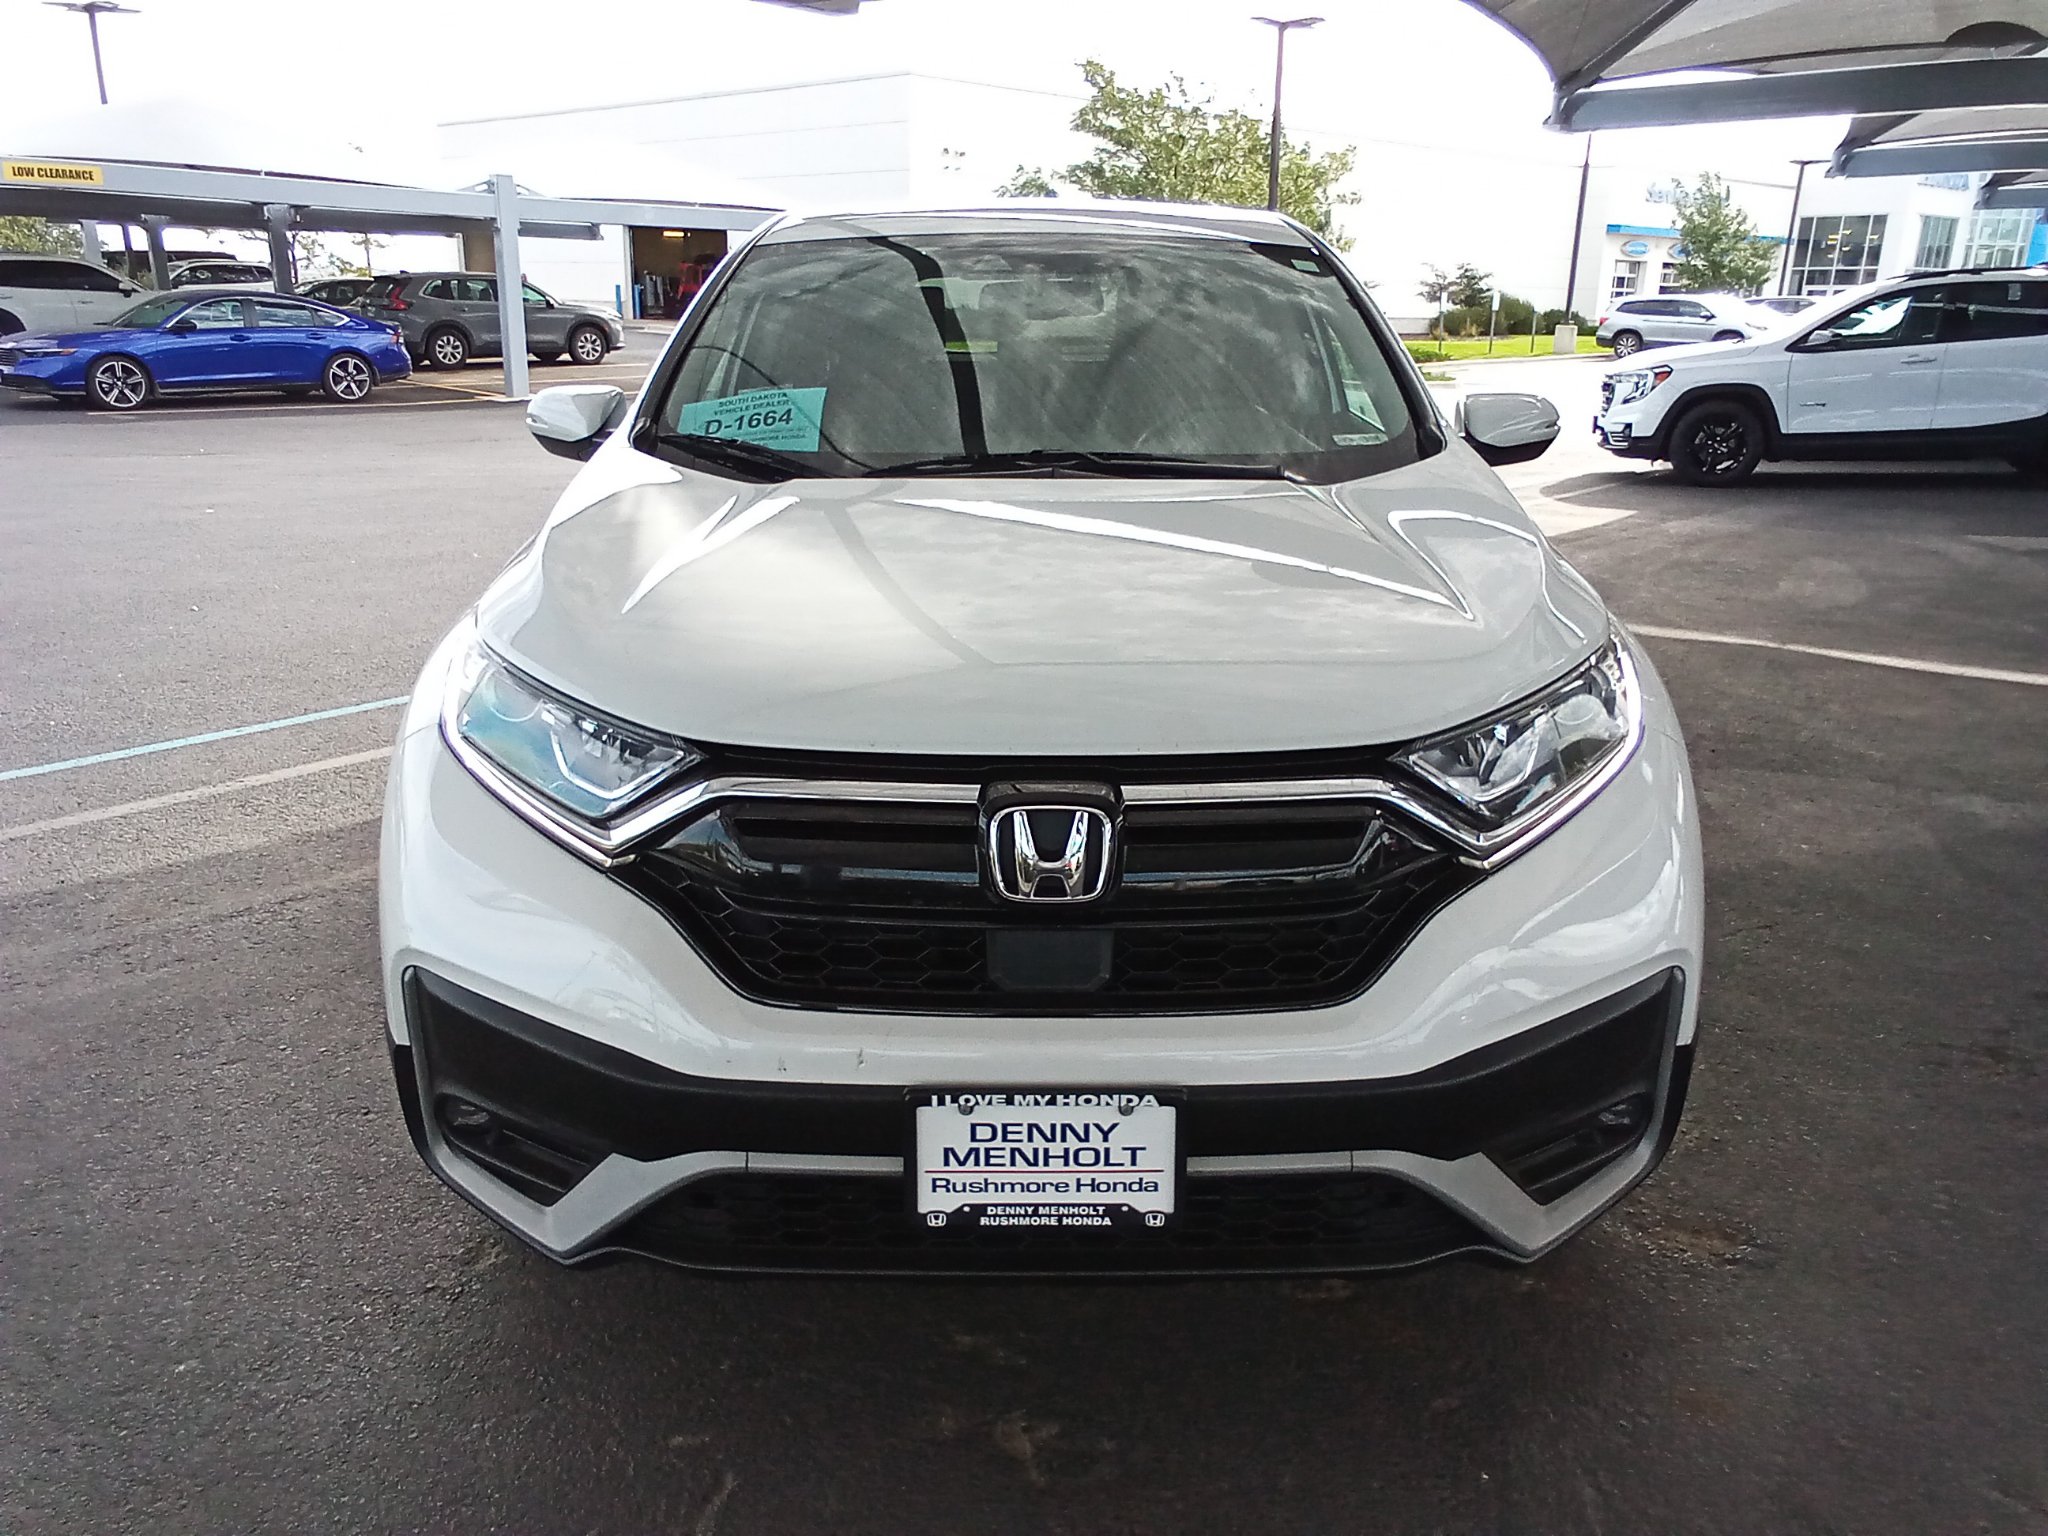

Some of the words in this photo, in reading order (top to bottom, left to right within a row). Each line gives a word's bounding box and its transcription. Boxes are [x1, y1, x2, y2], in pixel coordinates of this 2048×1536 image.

[12, 166, 35, 177] LOW
[37, 167, 95, 181] CLEARANCE
[713, 404, 751, 416] VEHICLE
[753, 400, 790, 410] DEALER
[718, 396, 750, 408] SOUTH
[750, 392, 788, 403] DAKOTA
[705, 408, 794, 436] D-1664
[931, 1095, 938, 1107] I
[944, 1094, 1007, 1107] LOVE
[1014, 1094, 1052, 1107] MY
[1056, 1094, 1160, 1107] HONDA
[969, 1122, 1121, 1143] DENNY
[942, 1146, 1147, 1167] MENHOLT
[931, 1177, 1070, 1193] Rushmore
[1075, 1177, 1159, 1193] Honda
[986, 1206, 1035, 1215] DENNY
[1038, 1206, 1106, 1215] MENHOLT
[979, 1216, 1059, 1226] RUSHMORE
[1062, 1216, 1112, 1226] HONDA
